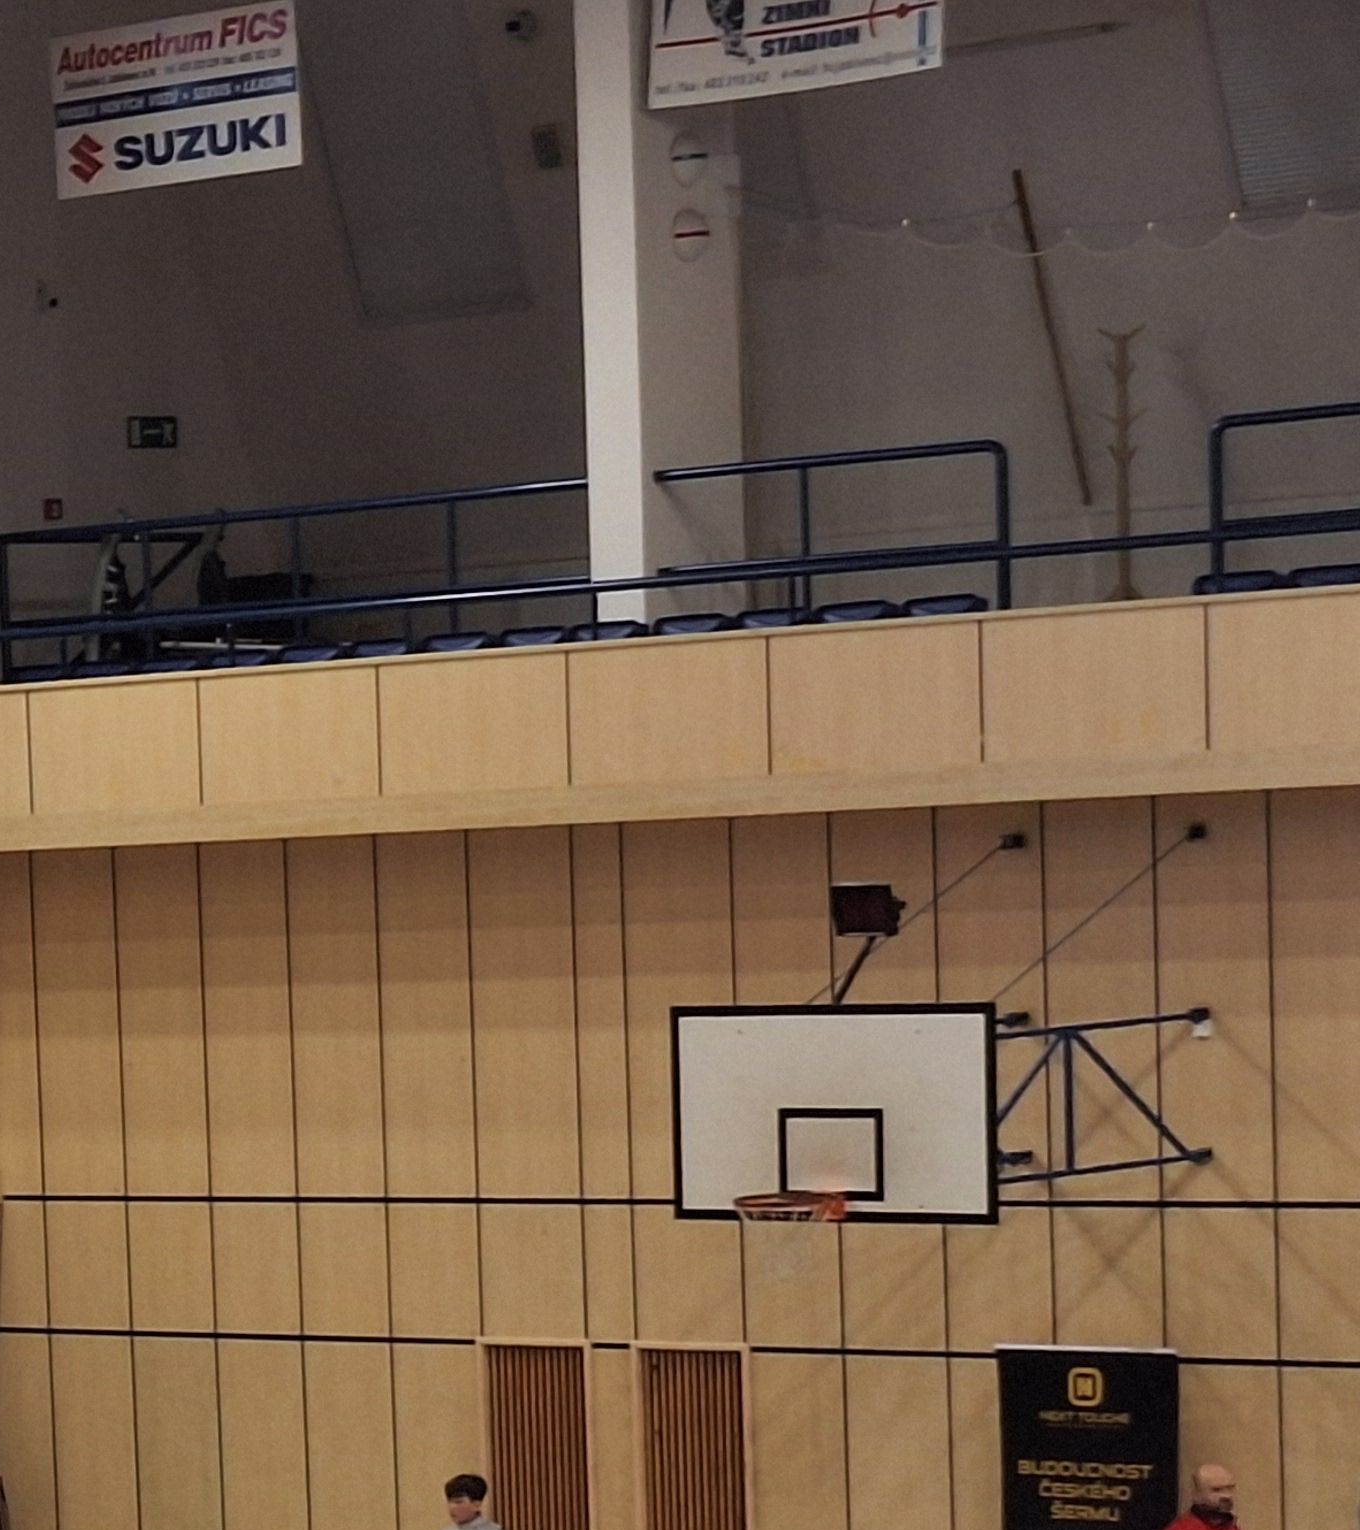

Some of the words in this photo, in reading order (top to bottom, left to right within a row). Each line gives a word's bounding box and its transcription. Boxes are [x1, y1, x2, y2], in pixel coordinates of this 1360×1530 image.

[57, 29, 213, 75] Autocentrum
[219, 9, 288, 48] FICS
[760, 26, 860, 58] STADION
[114, 113, 286, 171] SUZUKI
[1017, 1459, 1154, 1480] BUDOUCNOST
[1038, 1478, 1131, 1501] ČESKÉHO
[1050, 1500, 1120, 1522] ŠERMU
